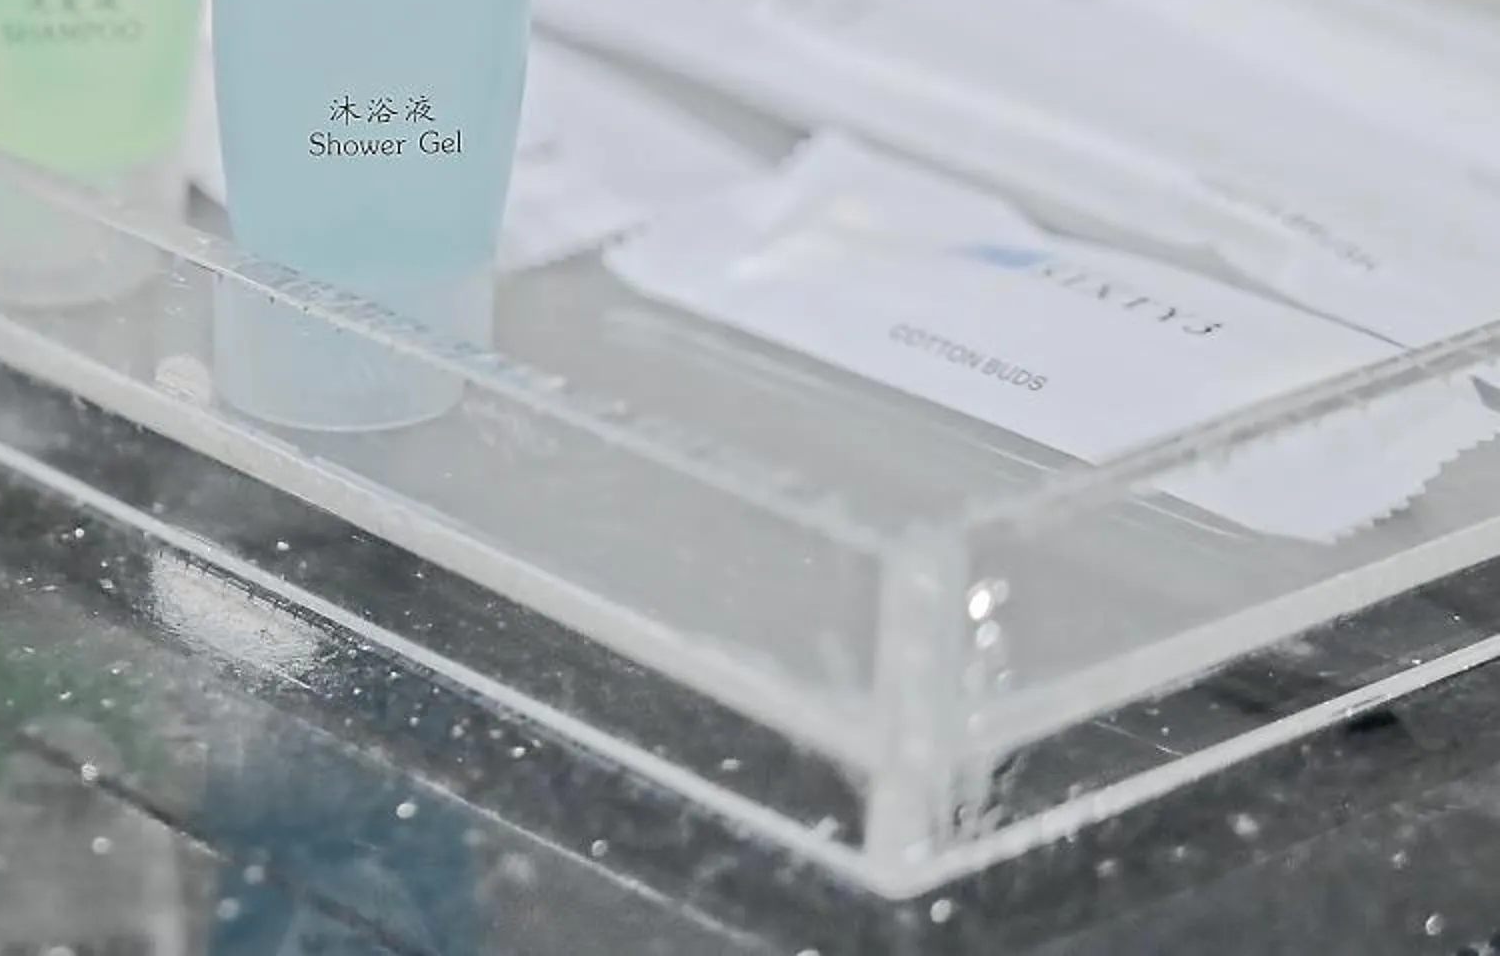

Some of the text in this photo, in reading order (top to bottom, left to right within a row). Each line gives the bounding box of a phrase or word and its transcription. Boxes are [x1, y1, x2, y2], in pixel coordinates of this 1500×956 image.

[330, 95, 436, 126] 沐浴液
[308, 129, 462, 156] Shower Gel
[888, 323, 1048, 392] COTTON BUDS
